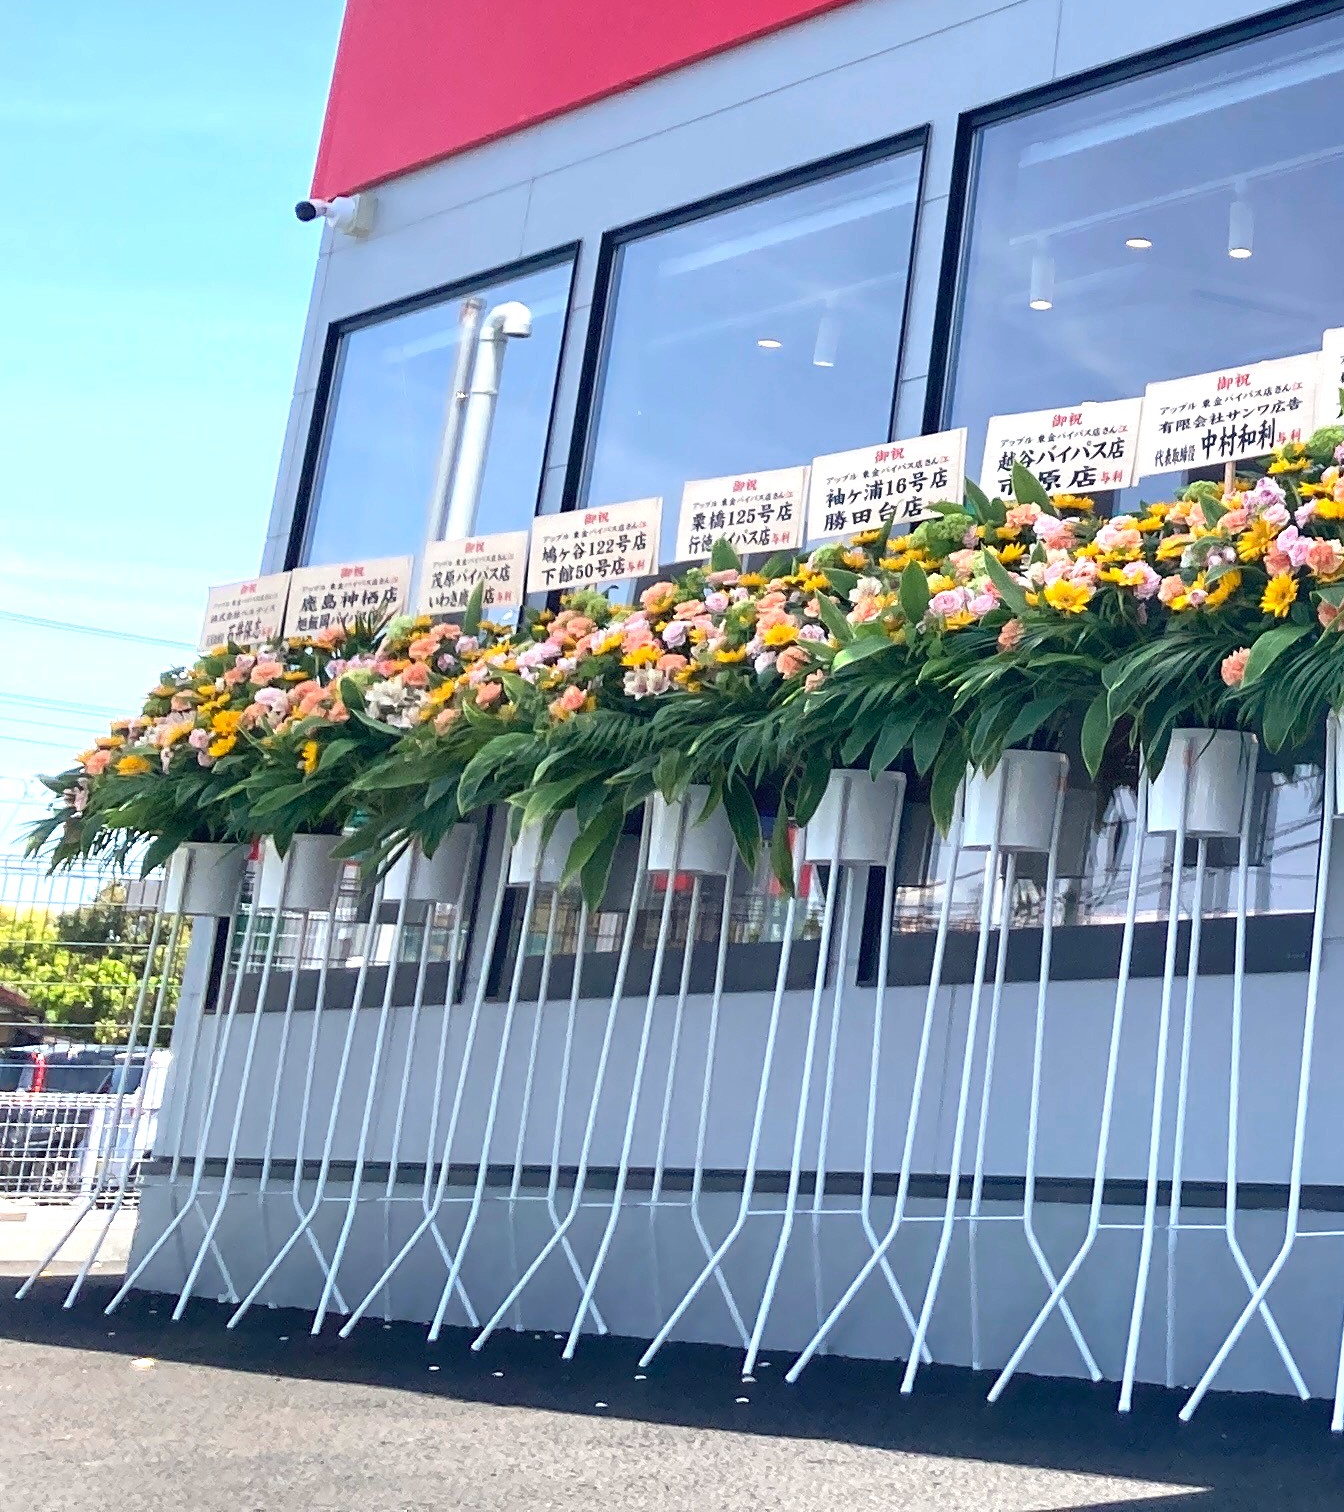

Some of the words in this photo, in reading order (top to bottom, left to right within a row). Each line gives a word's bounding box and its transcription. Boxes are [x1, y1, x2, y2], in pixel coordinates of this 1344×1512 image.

[1217, 373, 1251, 391] 御祝
[1052, 412, 1083, 428] 御祝
[1158, 396, 1304, 434] 有限会社サンワ広告
[1201, 417, 1276, 461] 中村和利
[875, 447, 905, 464] 御祝
[997, 437, 1125, 473] 越谷バイパス店
[733, 479, 757, 493] 御祝
[584, 511, 609, 525] 御祝
[691, 501, 792, 532] 栗橋125号店
[823, 495, 923, 532] 勝田台店
[541, 556, 626, 586] 下館50号店
